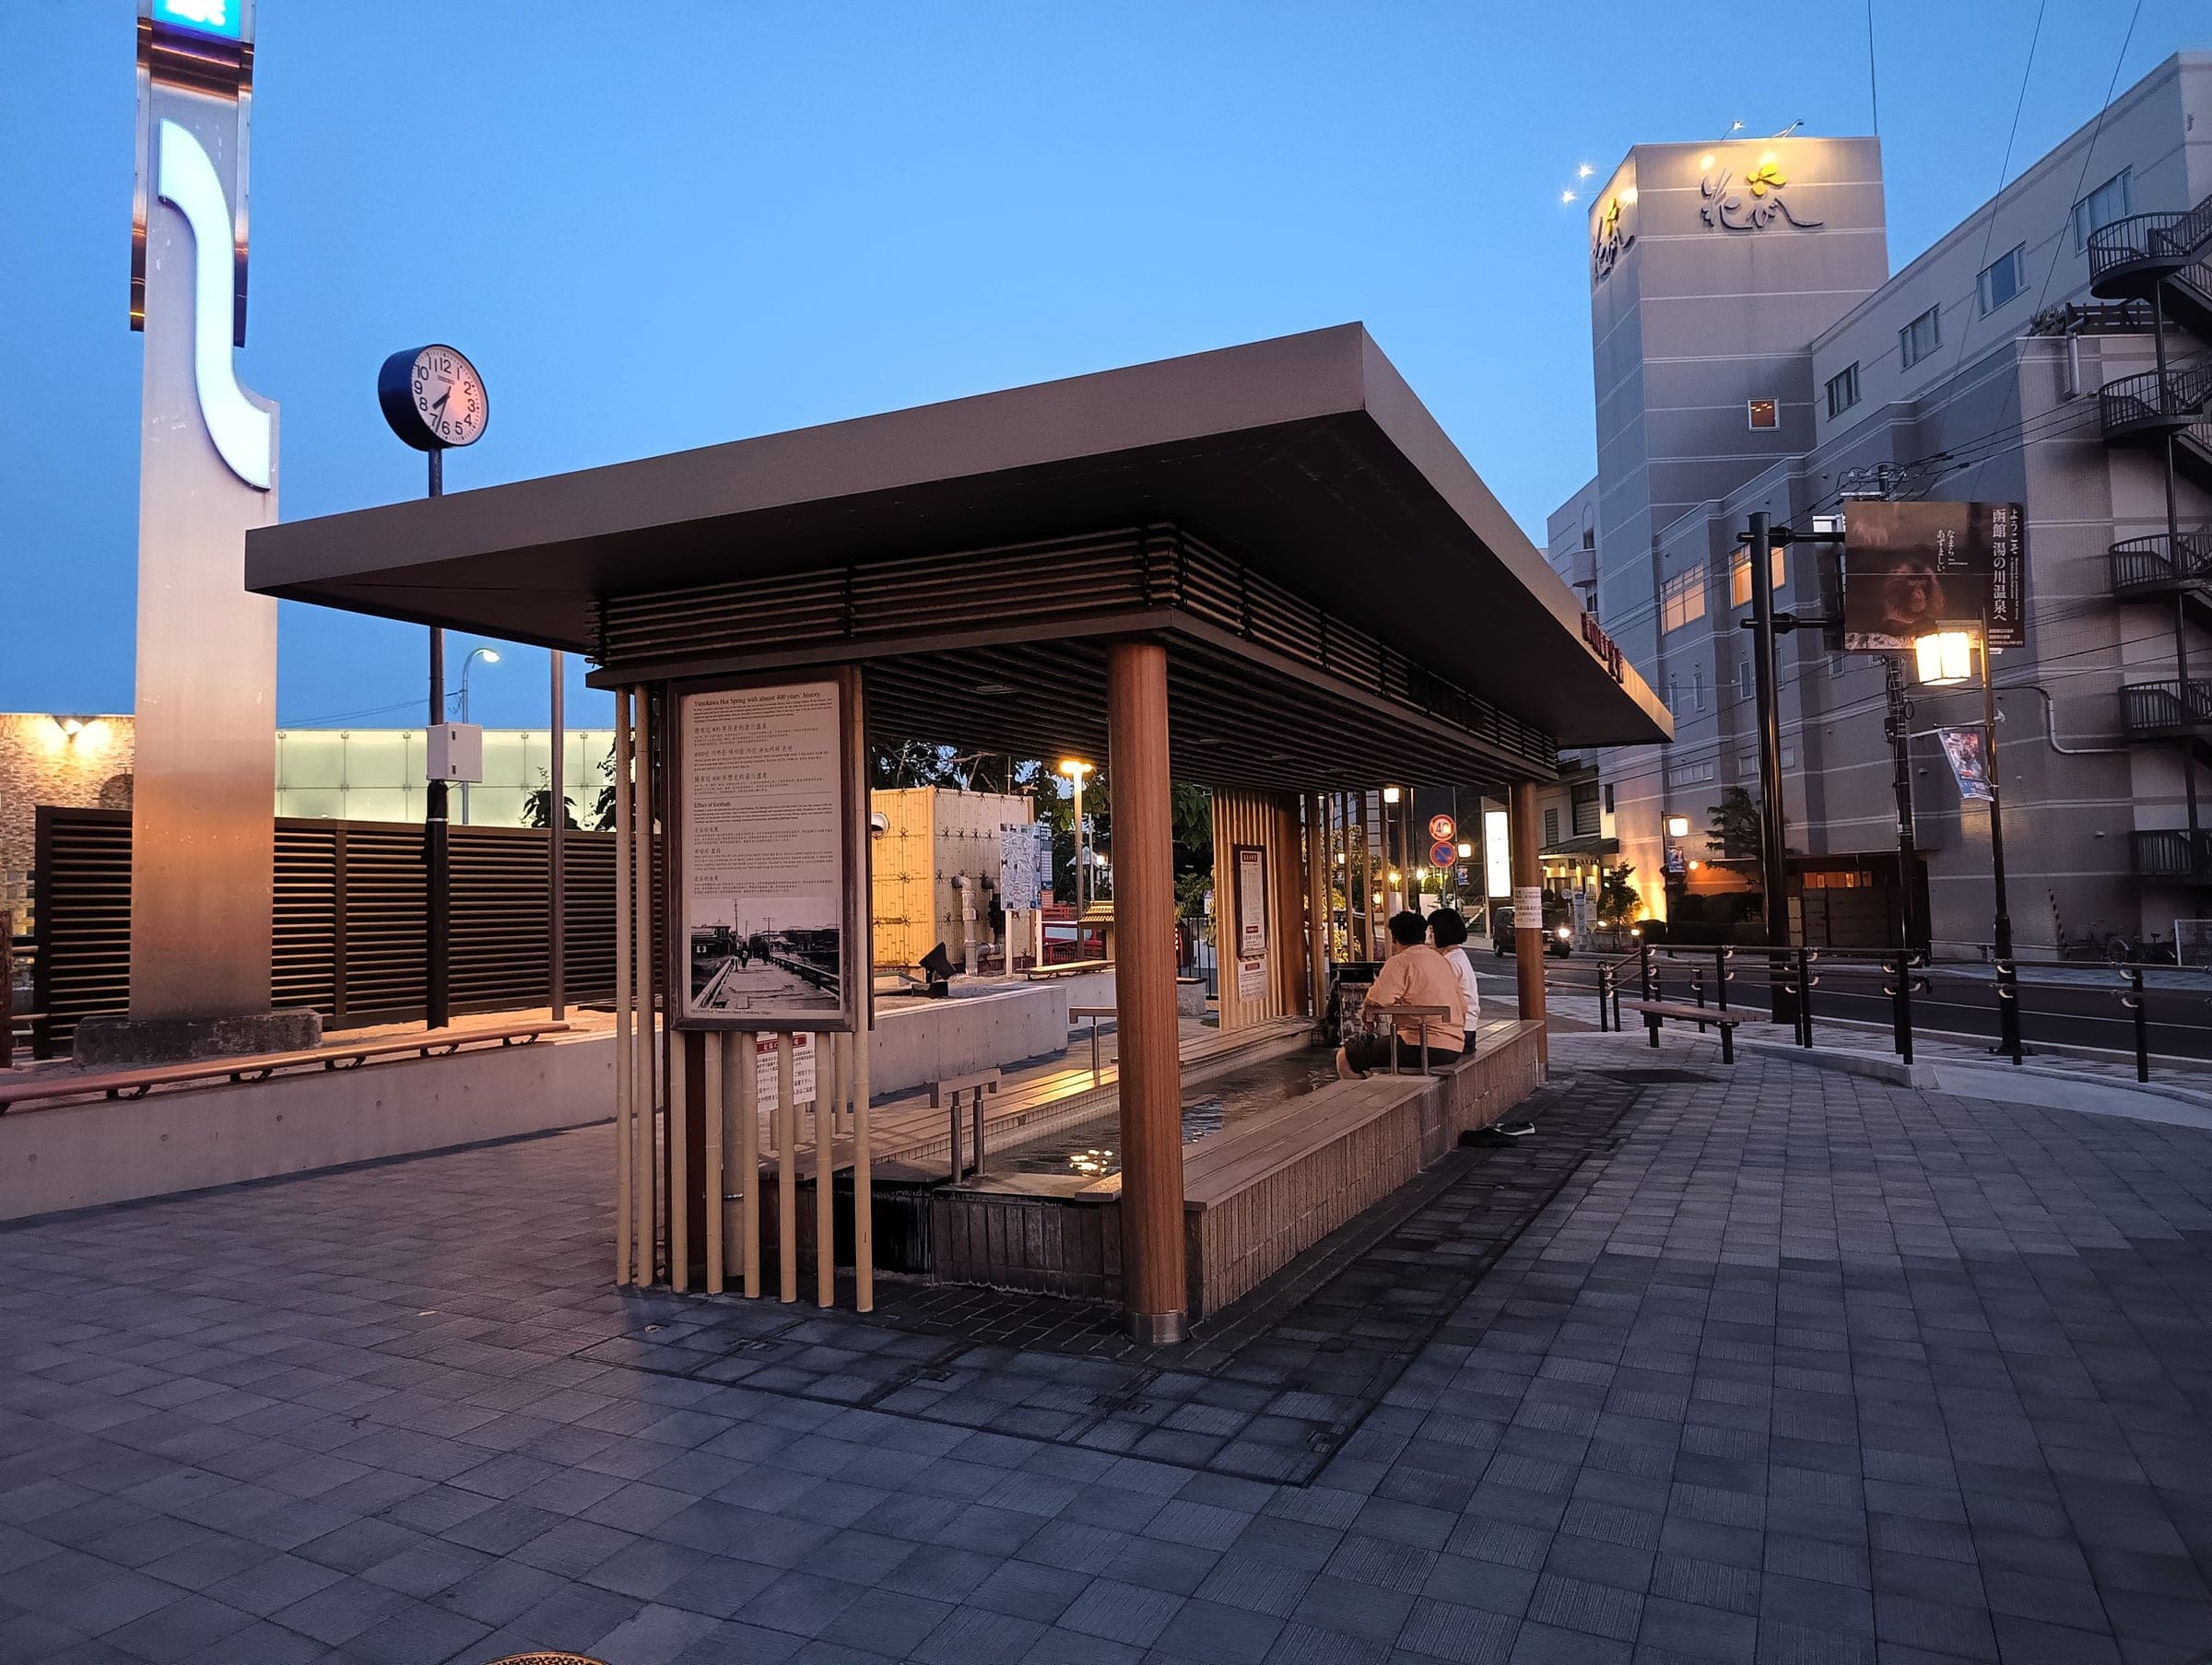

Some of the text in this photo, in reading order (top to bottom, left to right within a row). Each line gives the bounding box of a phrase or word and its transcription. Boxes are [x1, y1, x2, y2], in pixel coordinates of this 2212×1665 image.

[428, 357, 438, 373] 11
[440, 358, 452, 374] 12
[416, 365, 429, 381] 10
[414, 381, 423, 395] 9
[464, 381, 472, 396] 2
[419, 397, 429, 412] 8
[467, 398, 476, 413] 3
[429, 413, 439, 428] 7
[441, 420, 451, 436] 6
[455, 420, 464, 436] 5
[464, 413, 473, 428] 4
[2009, 509, 2019, 555] ようこそ
